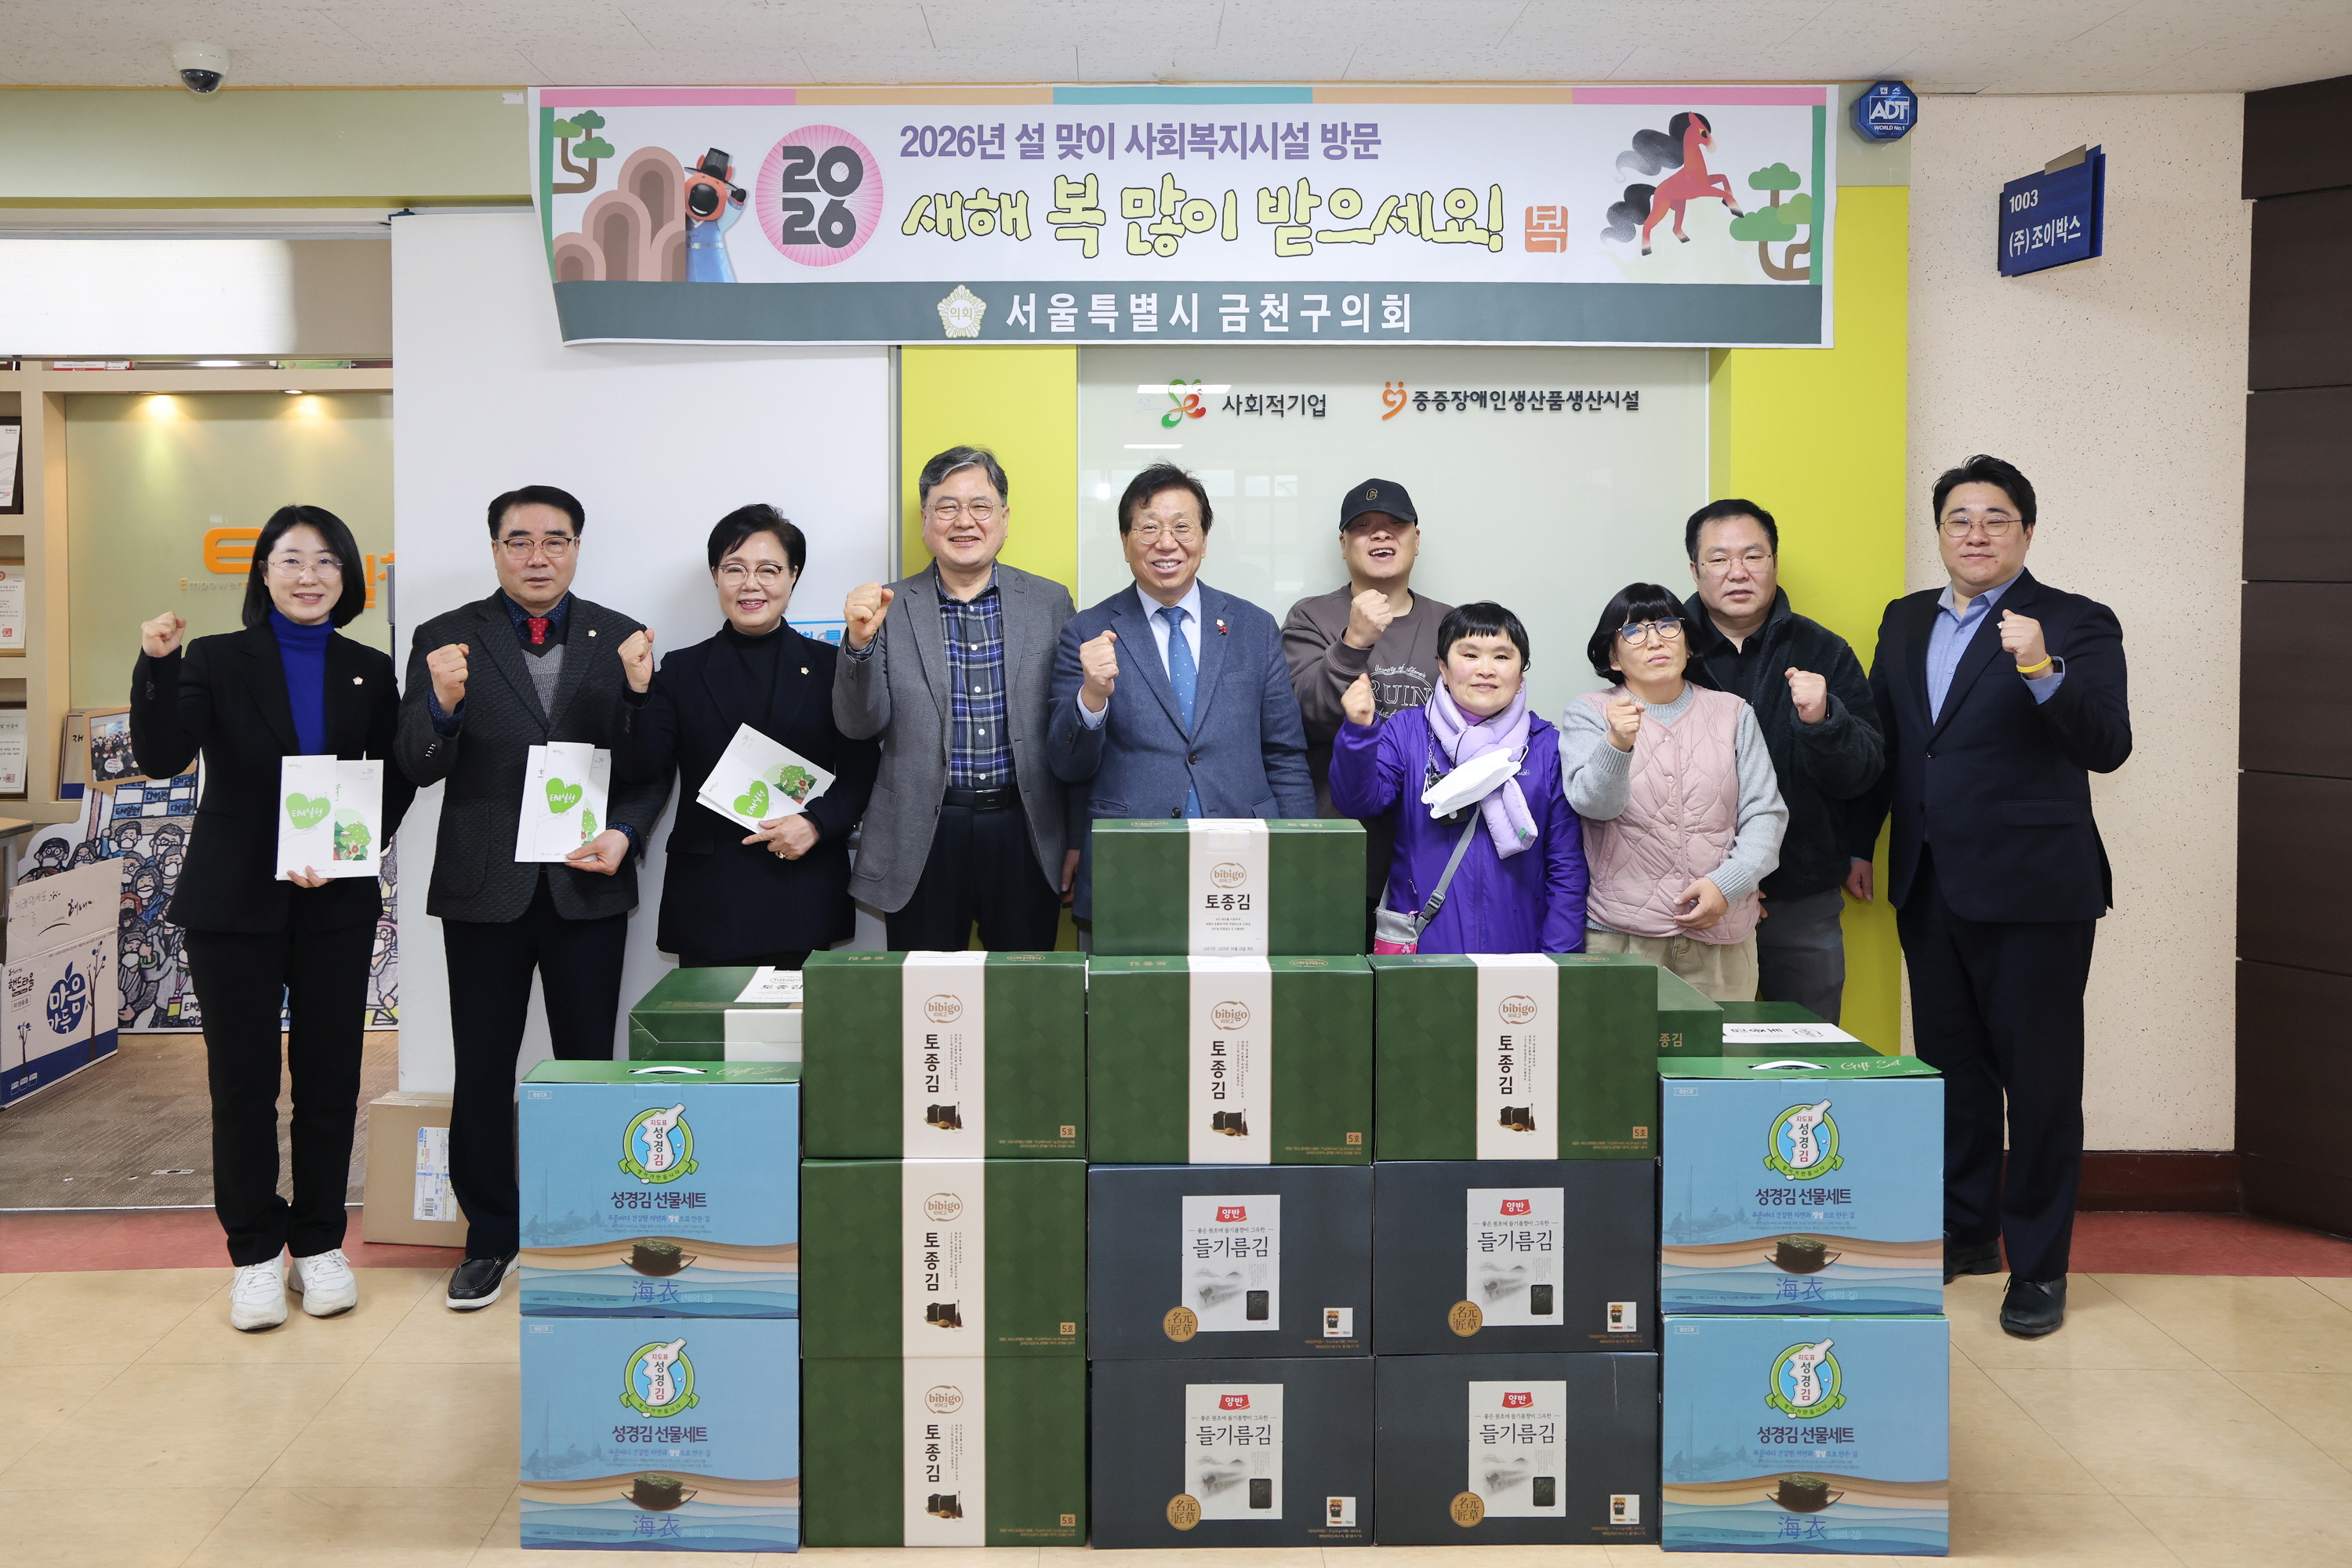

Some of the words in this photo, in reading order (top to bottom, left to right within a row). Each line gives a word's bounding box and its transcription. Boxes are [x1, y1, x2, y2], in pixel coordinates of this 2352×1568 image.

[1870, 101, 1909, 120] ADT
[900, 123, 1006, 161] 2026년
[1014, 123, 1044, 160] 설
[1055, 122, 1118, 161] 맞이
[1124, 122, 1312, 161] 사회복지시설
[1319, 122, 1381, 161] 방문
[782, 145, 863, 197] 20
[2009, 190, 2038, 213] 1003
[782, 198, 857, 249] 26
[901, 187, 1031, 241] 새해
[1047, 173, 1107, 259] 복
[1120, 172, 1239, 257] 많이
[1257, 176, 1504, 259] 받으세요!
[1526, 205, 1567, 253] 복
[2009, 216, 2082, 258] (주)조이박스
[949, 307, 973, 321] 의회
[1006, 292, 1200, 334] 서울특별시
[1218, 292, 1411, 335] 금천구의회
[1222, 394, 1326, 418] 사회적기업
[1412, 390, 1639, 412] 중증장애인생산품생산시설
[180, 578, 249, 591] Empower
[550, 793, 575, 804] EM실천
[746, 789, 765, 815] EM실천
[292, 807, 323, 818] EM실천
[1214, 869, 1244, 881] bibigo
[1205, 894, 1250, 911] 토종김
[9, 972, 34, 992] 핸드타올
[49, 977, 86, 1014] 마음
[927, 1002, 960, 1014] bibigo
[1214, 1008, 1247, 1021] bibigo
[1502, 1003, 1534, 1015] bibigo
[48, 1009, 72, 1034] 가득
[1657, 1033, 1683, 1047] 종김
[924, 1034, 940, 1093] 토종김
[1210, 1041, 1226, 1099] 토종김
[1497, 1035, 1514, 1095] 토종김
[1841, 1062, 1871, 1072] Gift
[1876, 1059, 1902, 1069] Set
[1348, 1134, 1360, 1143] 5호
[1635, 1128, 1646, 1137] 5호
[1798, 1123, 1809, 1163] 성경김
[653, 1127, 664, 1167] 성경김
[611, 1192, 652, 1209] 성경김
[654, 1192, 707, 1209] 선물세트
[927, 1200, 960, 1213] bibigo
[1506, 1201, 1525, 1212] 양반
[1755, 1189, 1796, 1206] 성경김
[1798, 1189, 1852, 1206] 선물세트
[1222, 1209, 1240, 1218] 양반
[1193, 1236, 1268, 1258] 들기름김
[1478, 1230, 1552, 1252] 들기름김
[924, 1232, 940, 1292] 토종김
[632, 1280, 680, 1303] 海衣
[1776, 1278, 1824, 1301] 海衣
[654, 1361, 665, 1400] 성경김
[1801, 1362, 1811, 1401] 성경김
[929, 1392, 961, 1405] bibigo
[1225, 1396, 1243, 1406] 양반
[1508, 1395, 1526, 1405] 양반
[612, 1425, 652, 1443] 성경김
[655, 1425, 708, 1443] 선물세트
[1196, 1424, 1271, 1446] 들기름김
[1479, 1423, 1555, 1444] 들기름김
[1757, 1427, 1798, 1444] 성경김
[1800, 1427, 1855, 1444] 선물세트
[925, 1425, 941, 1483] 토종김
[633, 1515, 680, 1537] 海衣
[1778, 1516, 1828, 1540] 海衣
